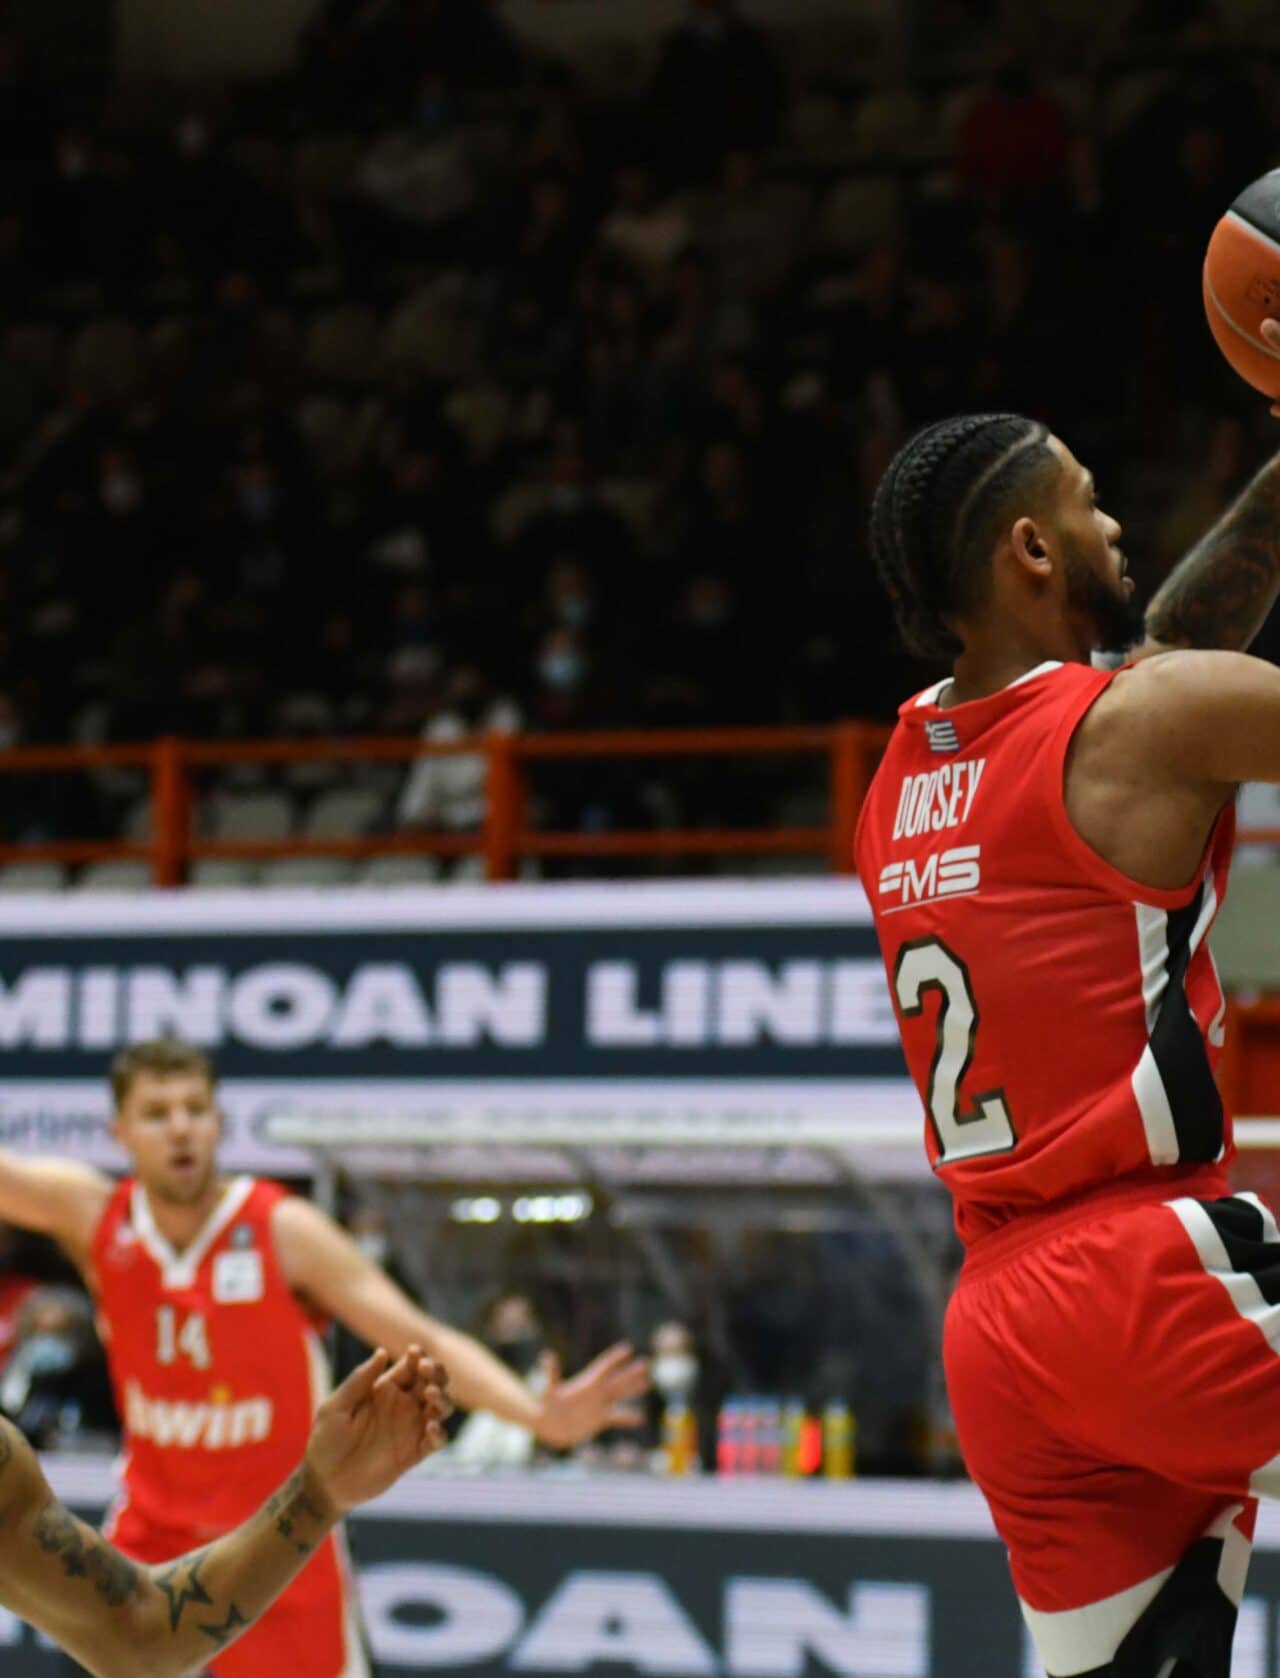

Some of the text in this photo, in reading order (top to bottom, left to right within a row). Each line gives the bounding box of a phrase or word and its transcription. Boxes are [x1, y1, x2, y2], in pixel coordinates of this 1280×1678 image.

[892, 758, 986, 841] DORSEY
[895, 935, 1018, 1168] 2
[154, 1304, 211, 1370] 14
